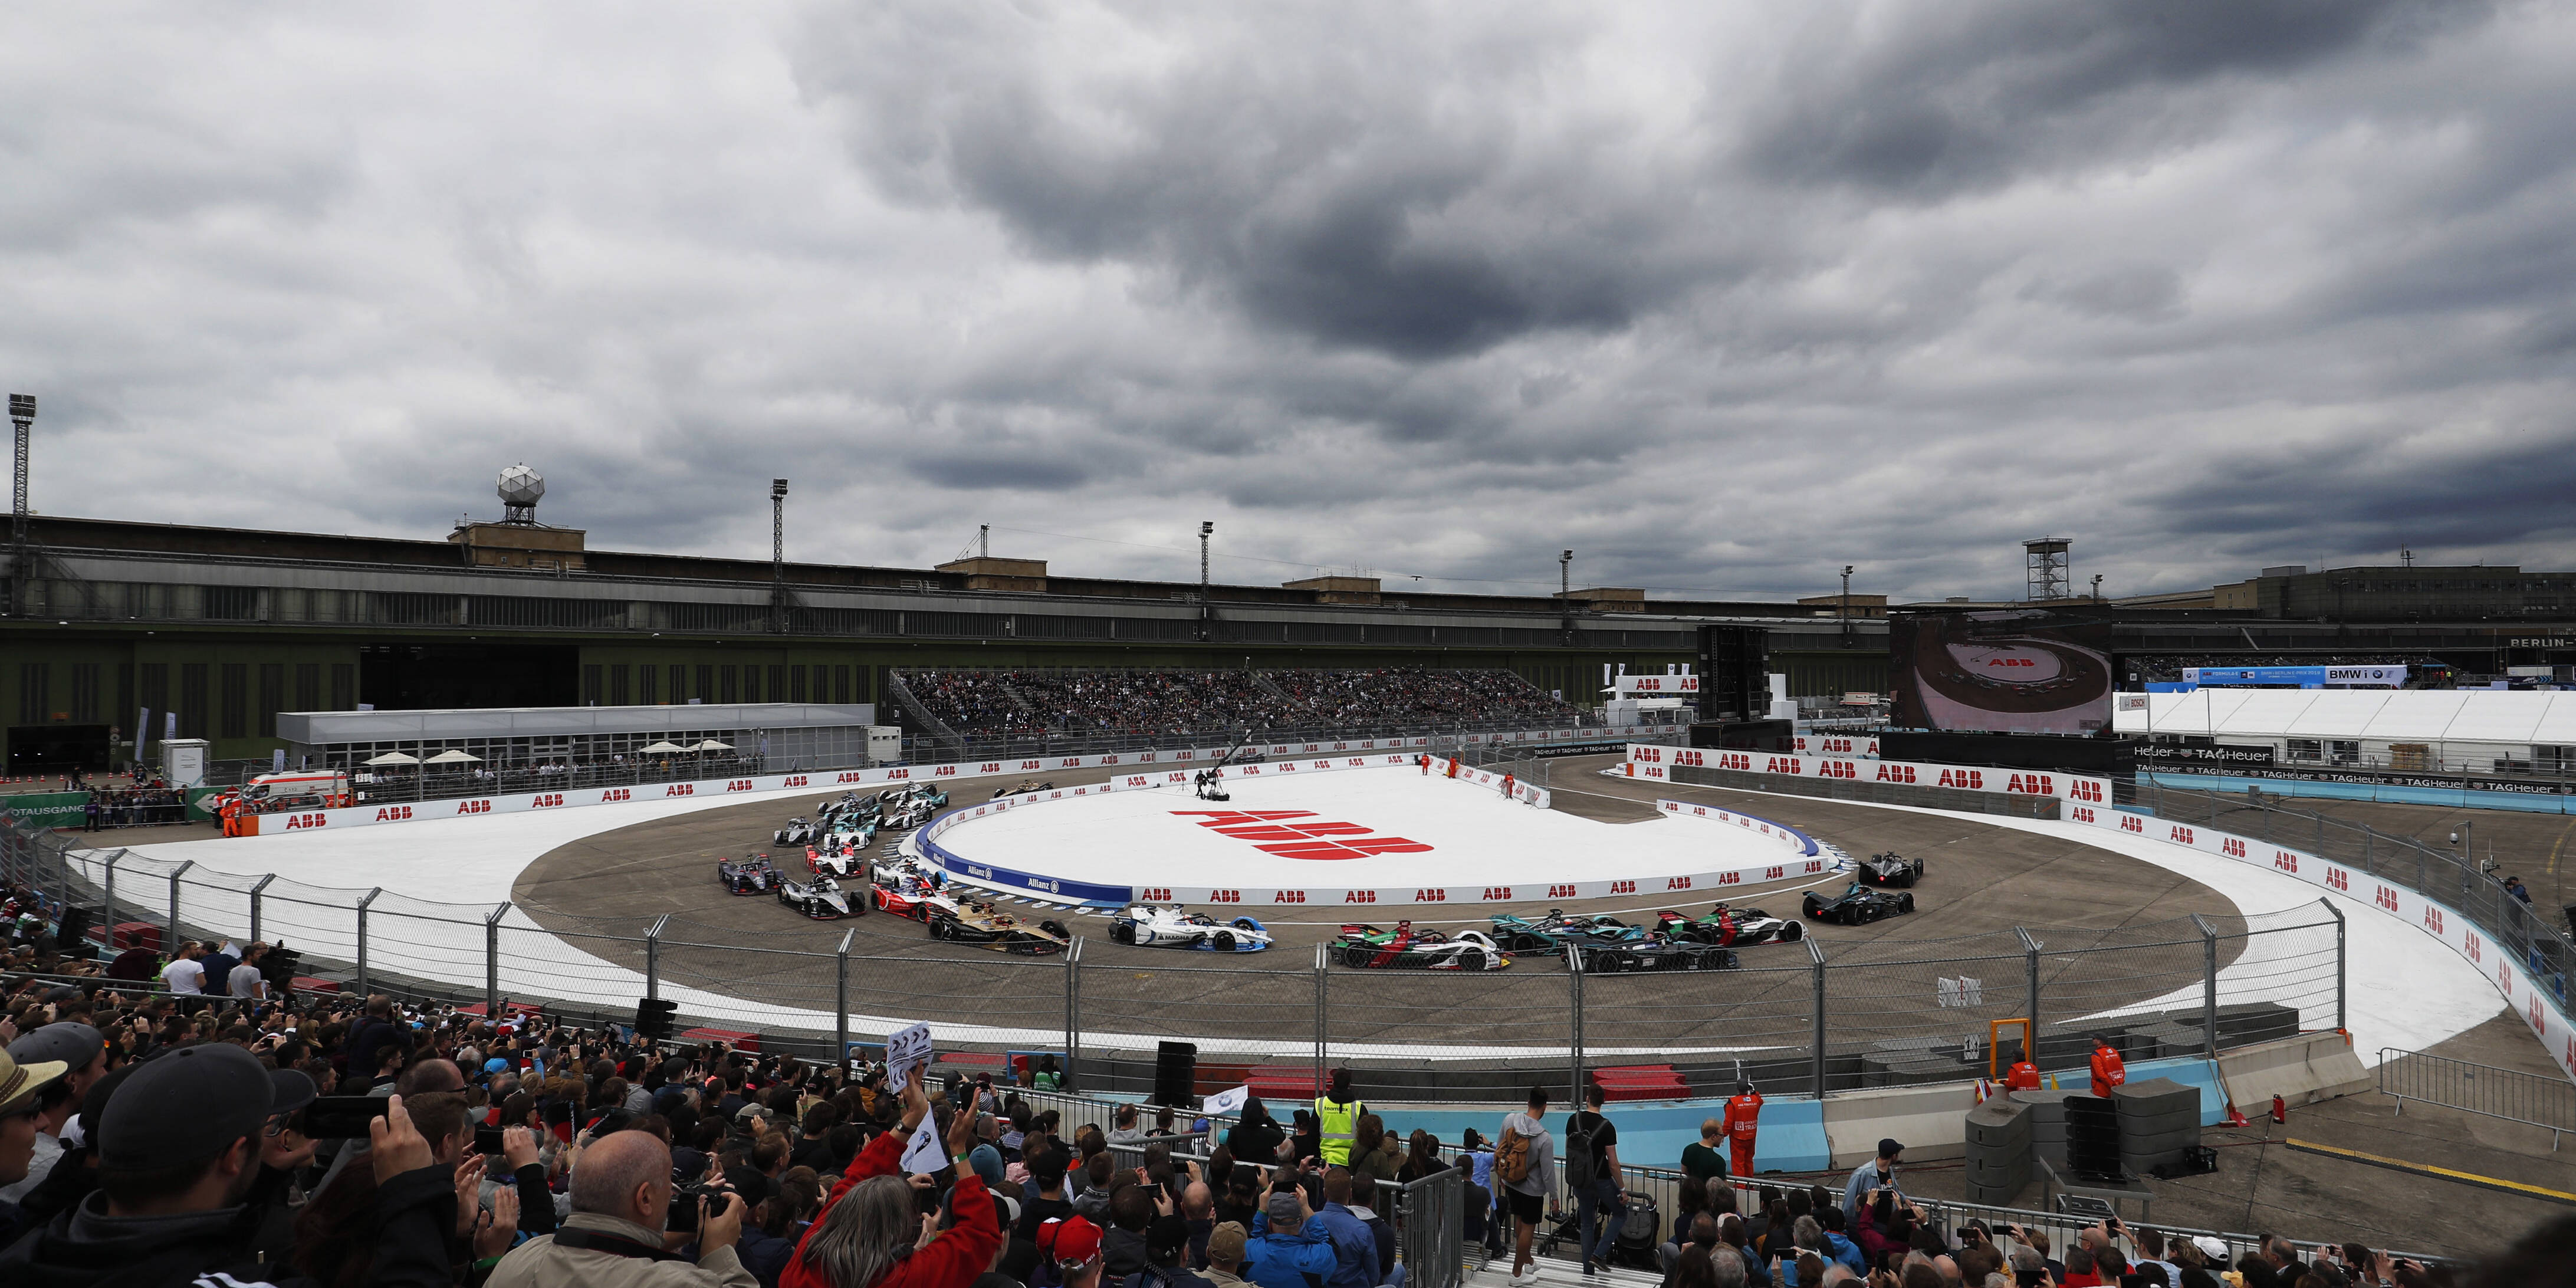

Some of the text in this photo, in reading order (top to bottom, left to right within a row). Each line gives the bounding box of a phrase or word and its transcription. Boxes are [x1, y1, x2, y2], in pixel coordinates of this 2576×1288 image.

[2511, 639, 2576, 647] BERLIN-
[2329, 670, 2367, 678] BMW i
[1637, 679, 1661, 690] ABB
[1680, 678, 1698, 690] AB
[2131, 699, 2145, 707] BOSCH
[894, 709, 900, 718] D1
[1822, 739, 1852, 753] ABB
[1211, 750, 1225, 758] ABB
[1634, 748, 1661, 763] ABB
[2134, 747, 2174, 757] Heuer
[2196, 749, 2269, 761] TAGHeuer
[1102, 755, 1118, 764] ABB
[1675, 751, 1703, 766] ABB
[1720, 754, 1750, 770] ABB
[936, 766, 955, 775] ABB
[981, 763, 1000, 772] ABB
[1022, 761, 1040, 769] ABB
[1244, 766, 1260, 774] ABB
[1280, 763, 1296, 771] ABB
[1767, 757, 1801, 774] ABB
[1819, 761, 1857, 778] ABB
[2136, 764, 2182, 773] TAGHeuer
[838, 773, 860, 782] ABB
[889, 769, 909, 778] ABB
[1168, 772, 1186, 783] ABB
[1647, 768, 1663, 777] ABB
[1877, 764, 1917, 784] ABB
[2197, 767, 2246, 777] TAGHeuer
[2261, 770, 2314, 780] TAGHeuer
[785, 776, 807, 786] ABB
[1128, 776, 1146, 786] ABB
[1938, 769, 1983, 788] ABB
[2331, 774, 2387, 784] TAGHeuer
[2406, 778, 2465, 788] TAGHeuer
[667, 784, 694, 796] ABB
[728, 780, 753, 791] ABB
[2007, 774, 2053, 795] ABB
[2486, 783, 2554, 793] TAGHeuer
[603, 789, 630, 801] ABB
[2071, 780, 2102, 803] ABB
[533, 794, 563, 807] ABB
[11, 804, 86, 816] OTAUSGANG
[458, 800, 491, 814] ABB
[975, 807, 985, 816] ABB
[995, 803, 1006, 811] ABB
[1665, 803, 1678, 811] ABB
[1693, 807, 1706, 816] ABB
[377, 807, 412, 821] ABB
[1719, 812, 1729, 821] ABB
[2072, 807, 2095, 823] ABB
[287, 814, 326, 829] ABB
[1740, 817, 1750, 827] ABB
[2121, 816, 2143, 833] ABB
[1760, 823, 1769, 834] ABB
[1167, 811, 1434, 860] ABB
[2171, 826, 2194, 845] ABB
[2223, 838, 2246, 857] ABB
[1806, 861, 1821, 873] ABB
[2275, 851, 2298, 873] ABB
[968, 865, 985, 876] Allianz
[1766, 866, 1783, 879] ABB
[1720, 872, 1740, 883] ABB
[2327, 867, 2348, 891] ABB
[1028, 878, 1050, 890] Allianz
[1612, 881, 1636, 893] ABB
[1668, 878, 1691, 889] ABB
[1143, 888, 1171, 901] ABB
[1416, 889, 1445, 901] ABB
[1484, 888, 1512, 899] ABB
[1549, 885, 1576, 896] ABB
[1211, 891, 1240, 902] ABB
[1276, 891, 1306, 903] ABB
[1346, 891, 1376, 902] ABB
[2376, 885, 2398, 912] ABB
[2424, 905, 2443, 935] ABB
[2465, 929, 2480, 962] ABB
[2499, 957, 2511, 995] ABB
[2529, 992, 2545, 1035] ABB
[1086, 1253, 1096, 1264] AVIS
